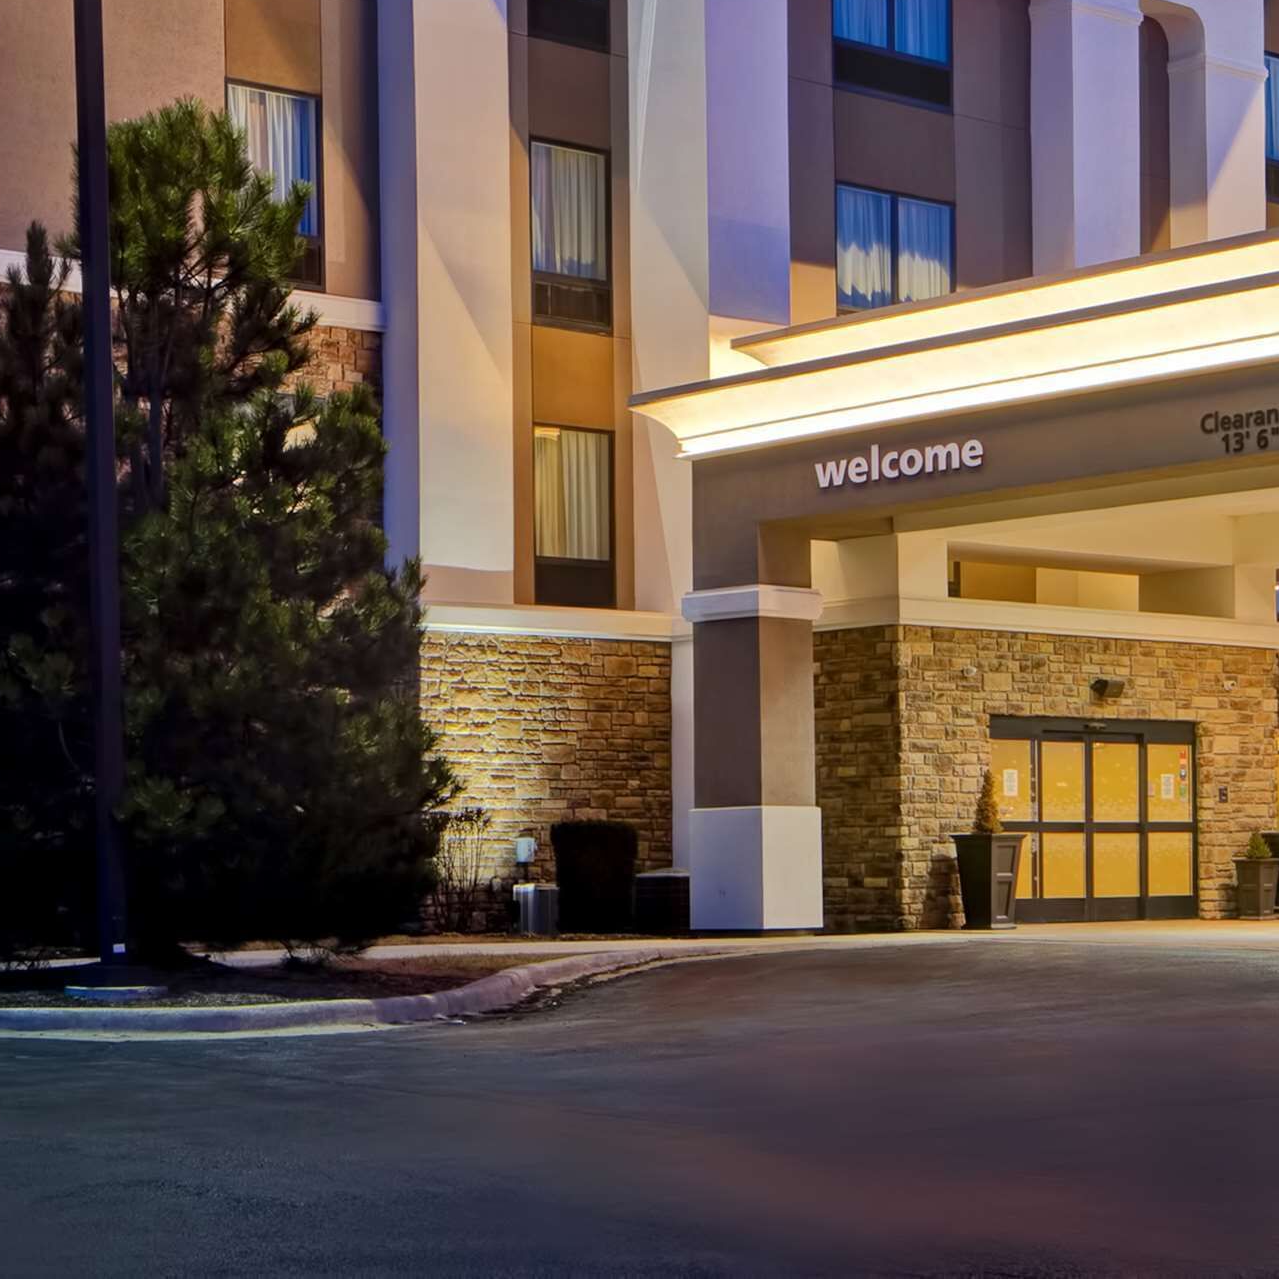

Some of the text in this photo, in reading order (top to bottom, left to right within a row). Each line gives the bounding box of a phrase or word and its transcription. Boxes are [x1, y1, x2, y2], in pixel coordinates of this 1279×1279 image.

[1221, 426, 1279, 454] 13' 6"
[814, 438, 984, 489] welcome
